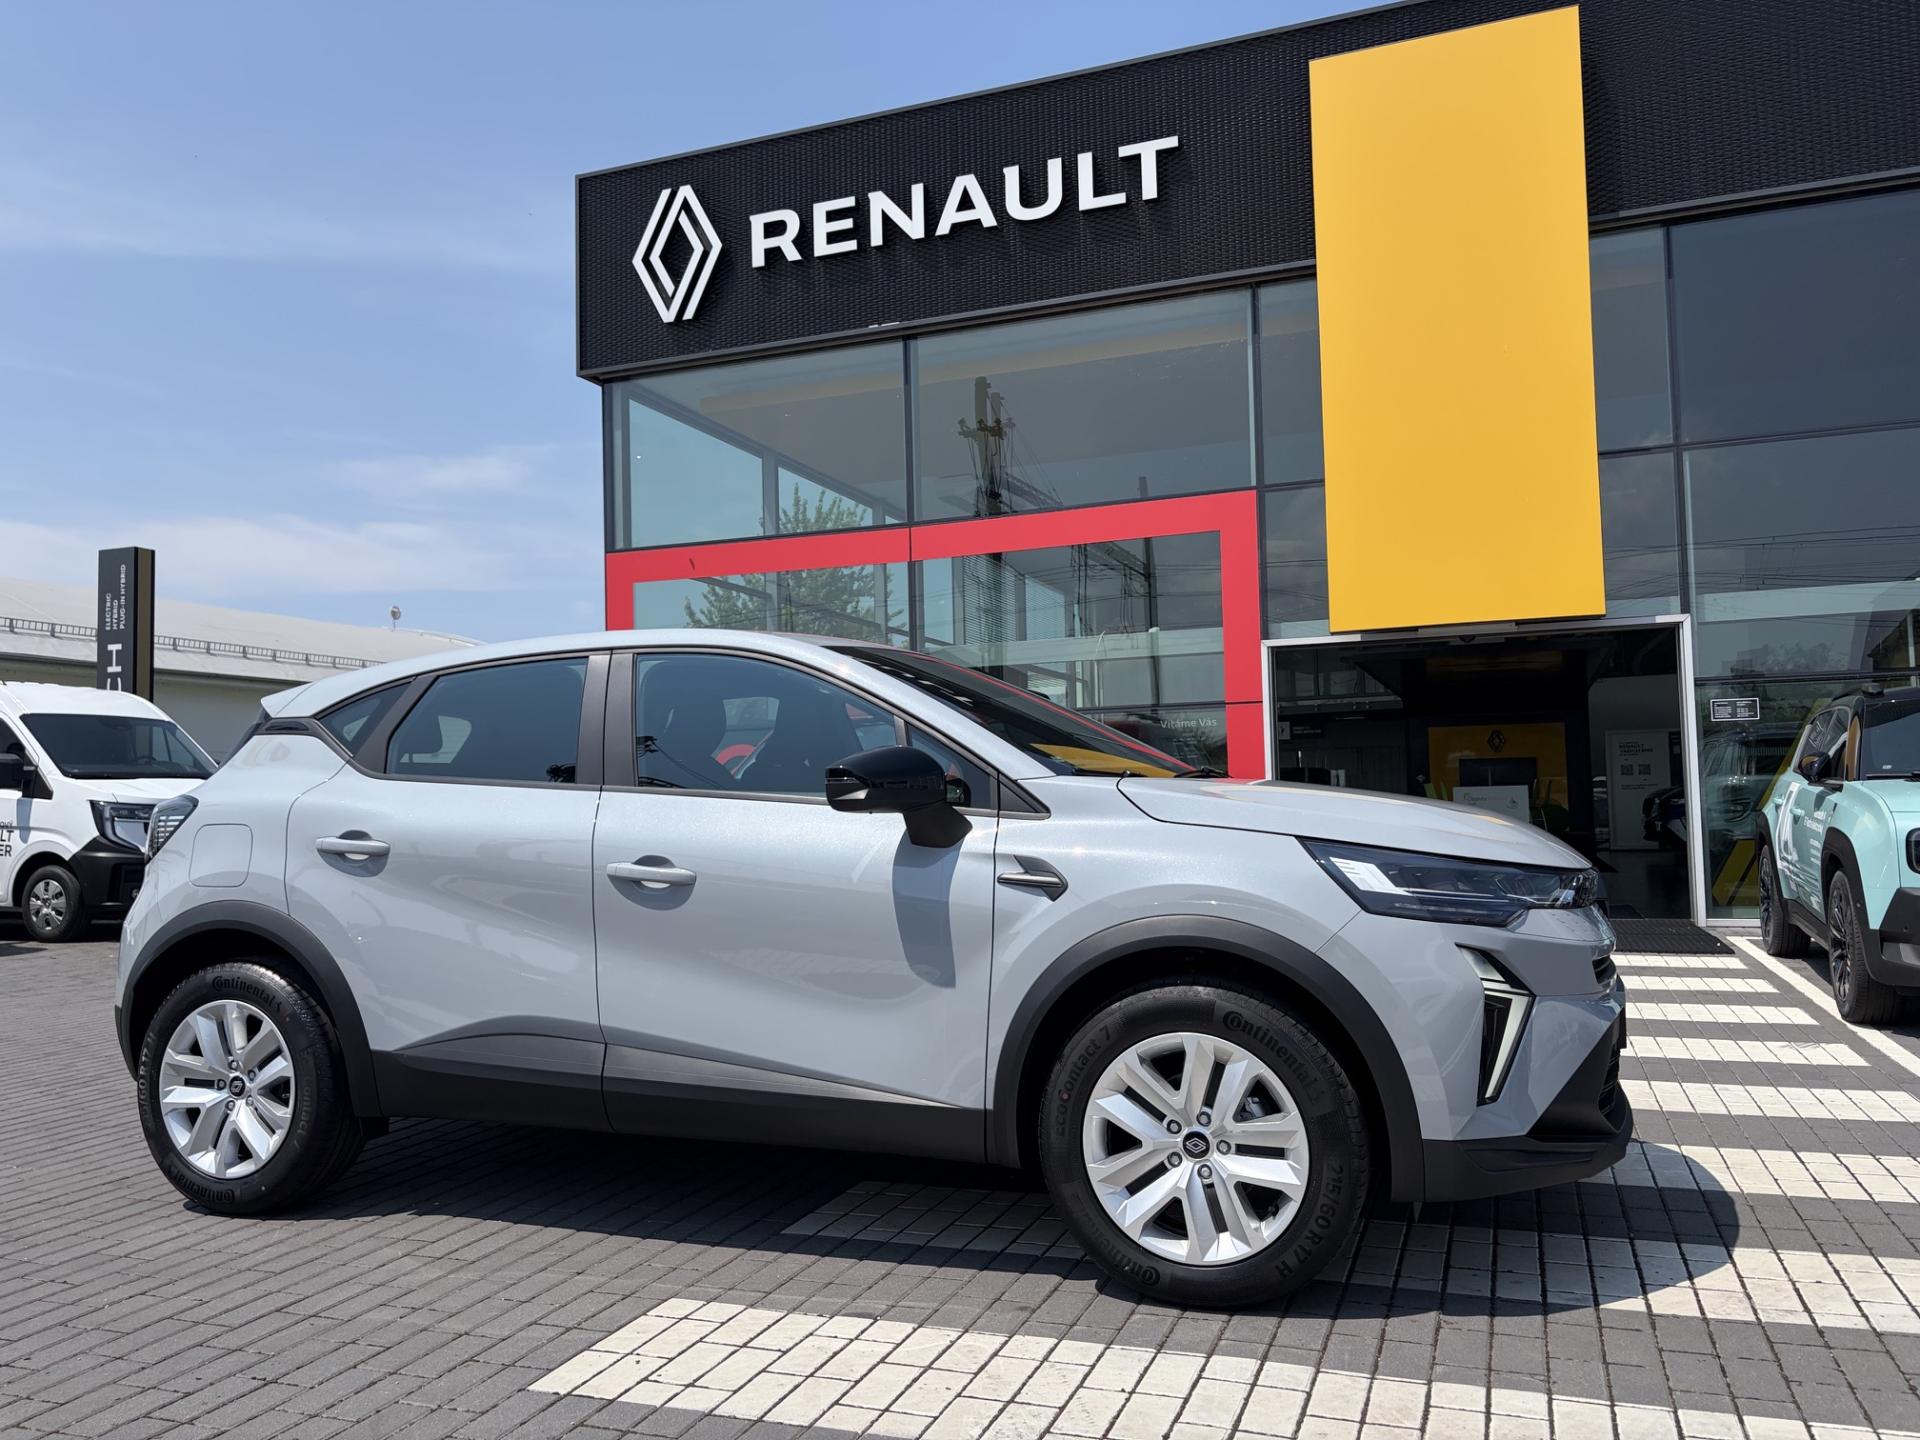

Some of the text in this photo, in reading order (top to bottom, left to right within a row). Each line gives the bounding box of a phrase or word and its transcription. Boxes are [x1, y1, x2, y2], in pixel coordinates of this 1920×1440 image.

[749, 135, 1179, 269] RENAULT
[212, 975, 274, 1005] Continental
[1099, 1025, 1111, 1040] 7
[1223, 1011, 1318, 1088] Continental
[1315, 1164, 1344, 1229] 215/60
